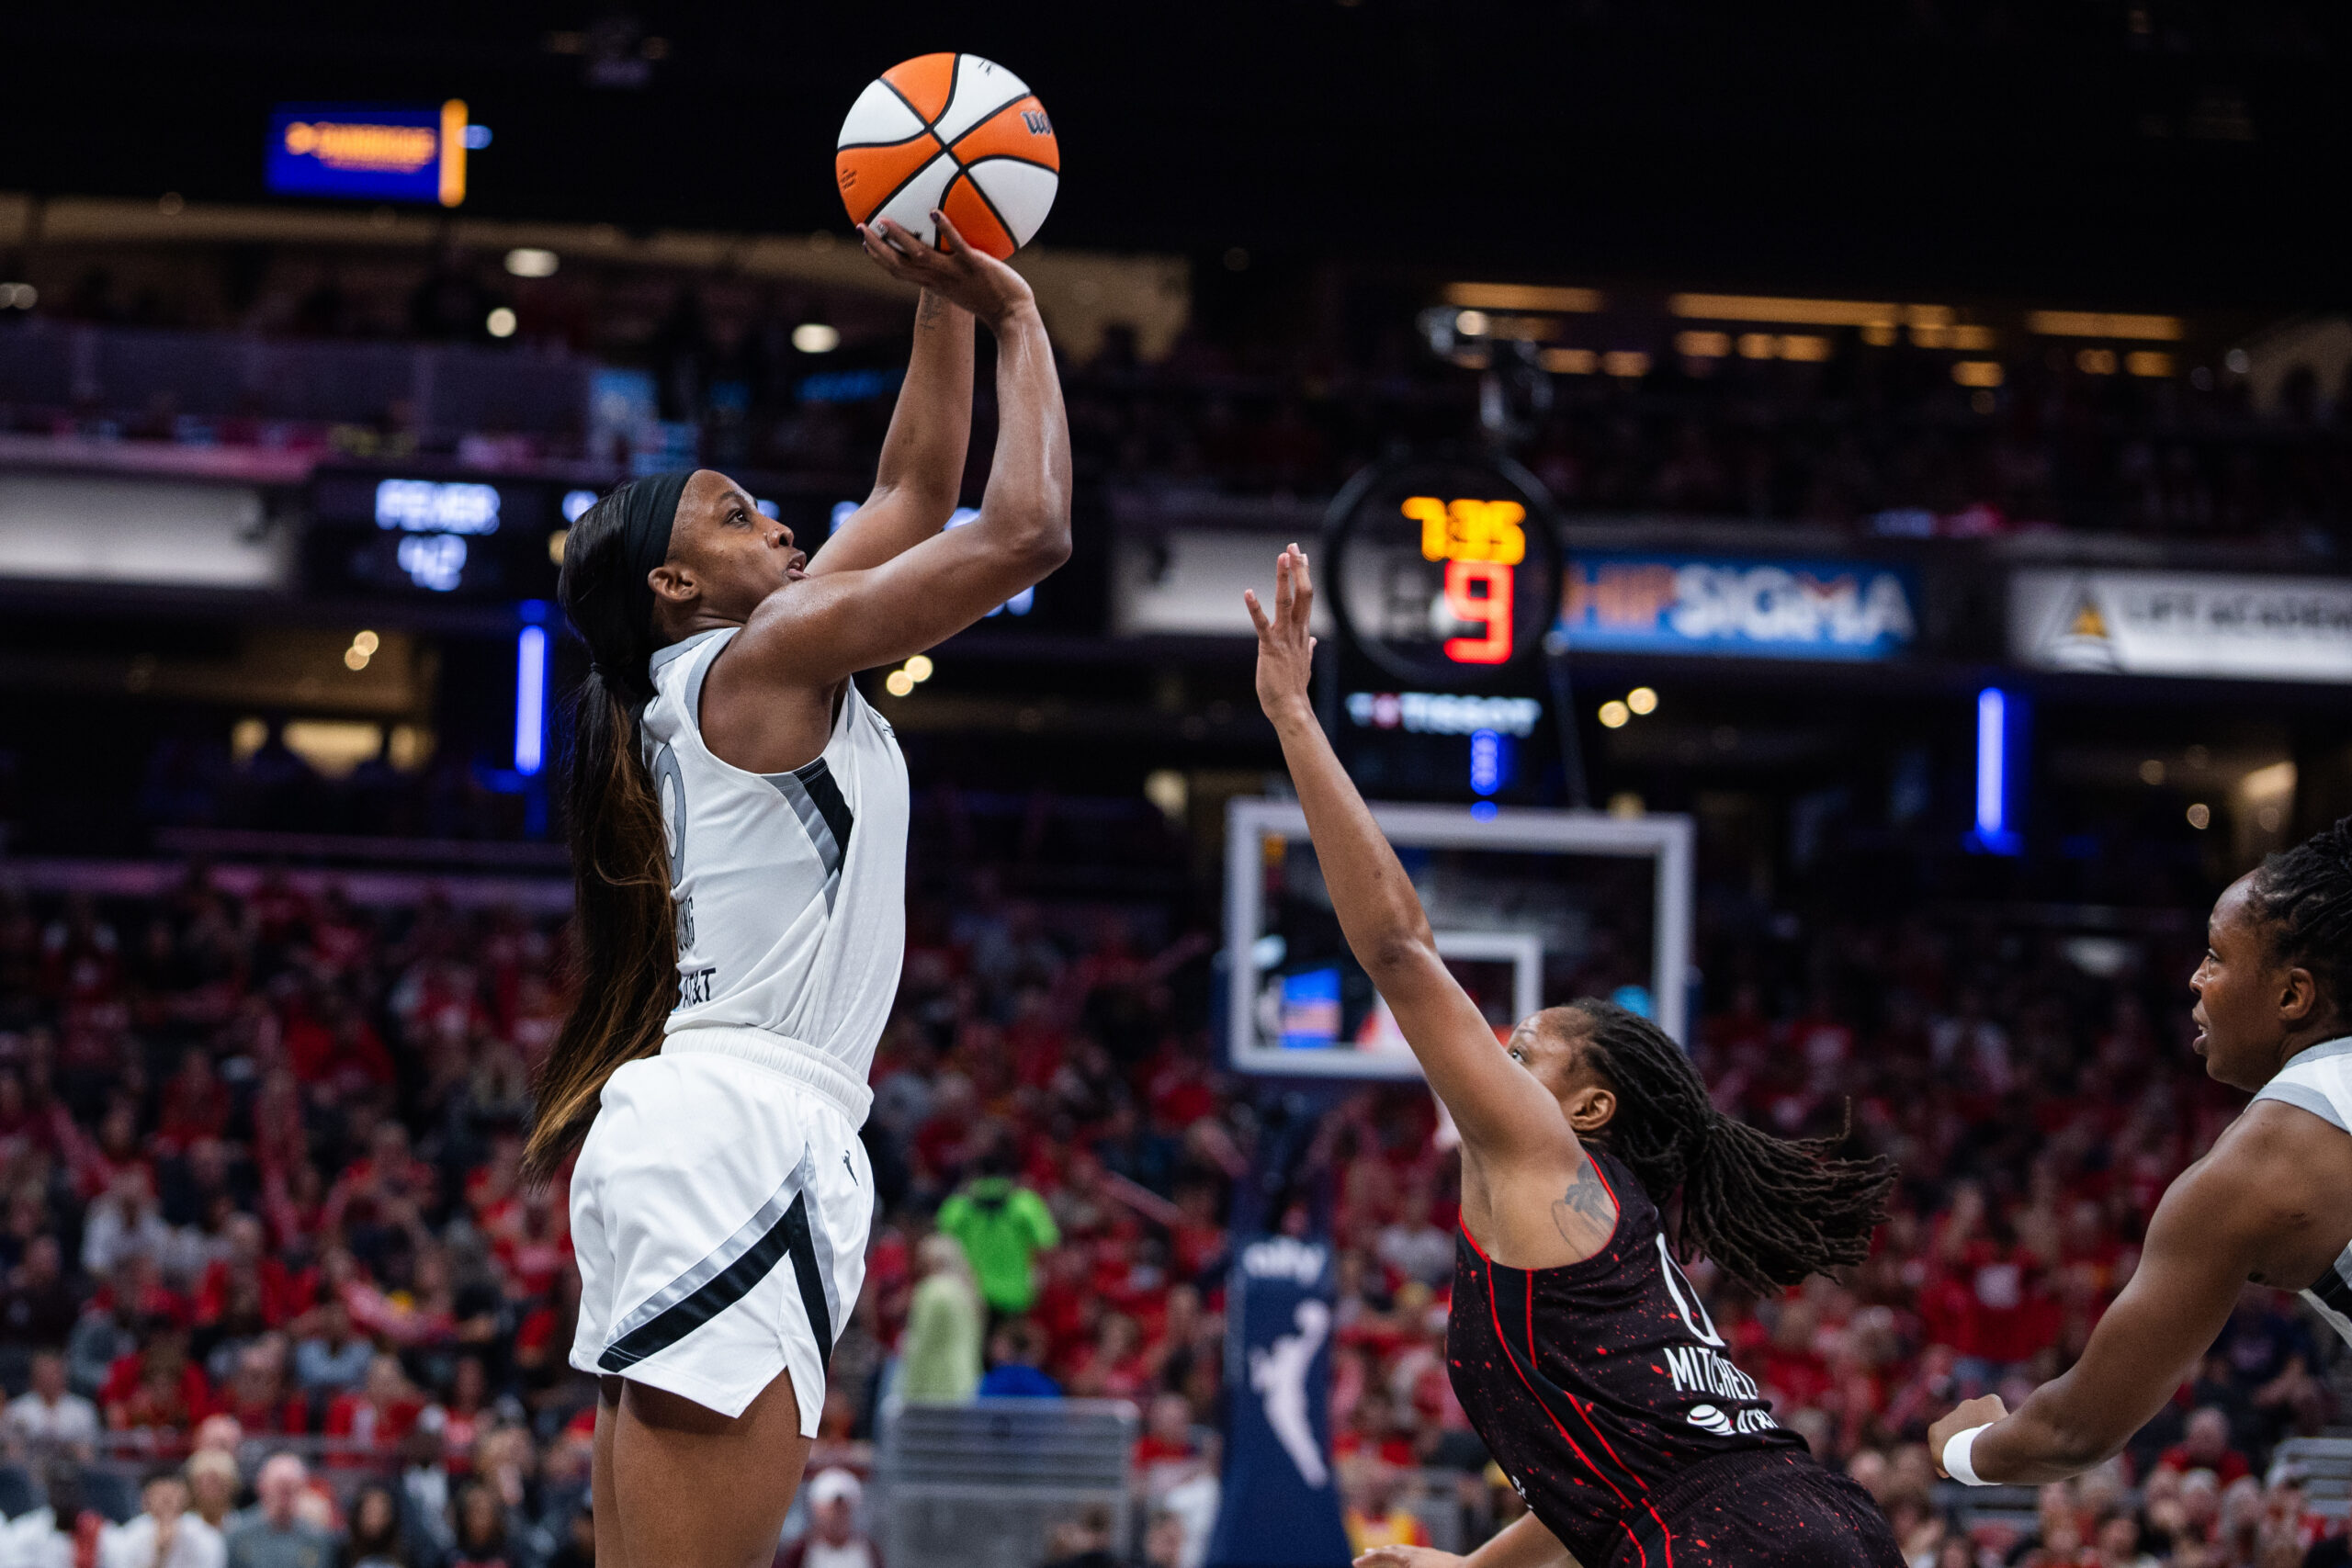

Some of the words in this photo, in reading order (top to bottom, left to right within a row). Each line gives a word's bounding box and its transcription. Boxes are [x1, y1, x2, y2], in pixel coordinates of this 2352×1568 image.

[1443, 559, 1514, 664] 9
[676, 896, 695, 952] UNG
[682, 966, 716, 1009] AT&T
